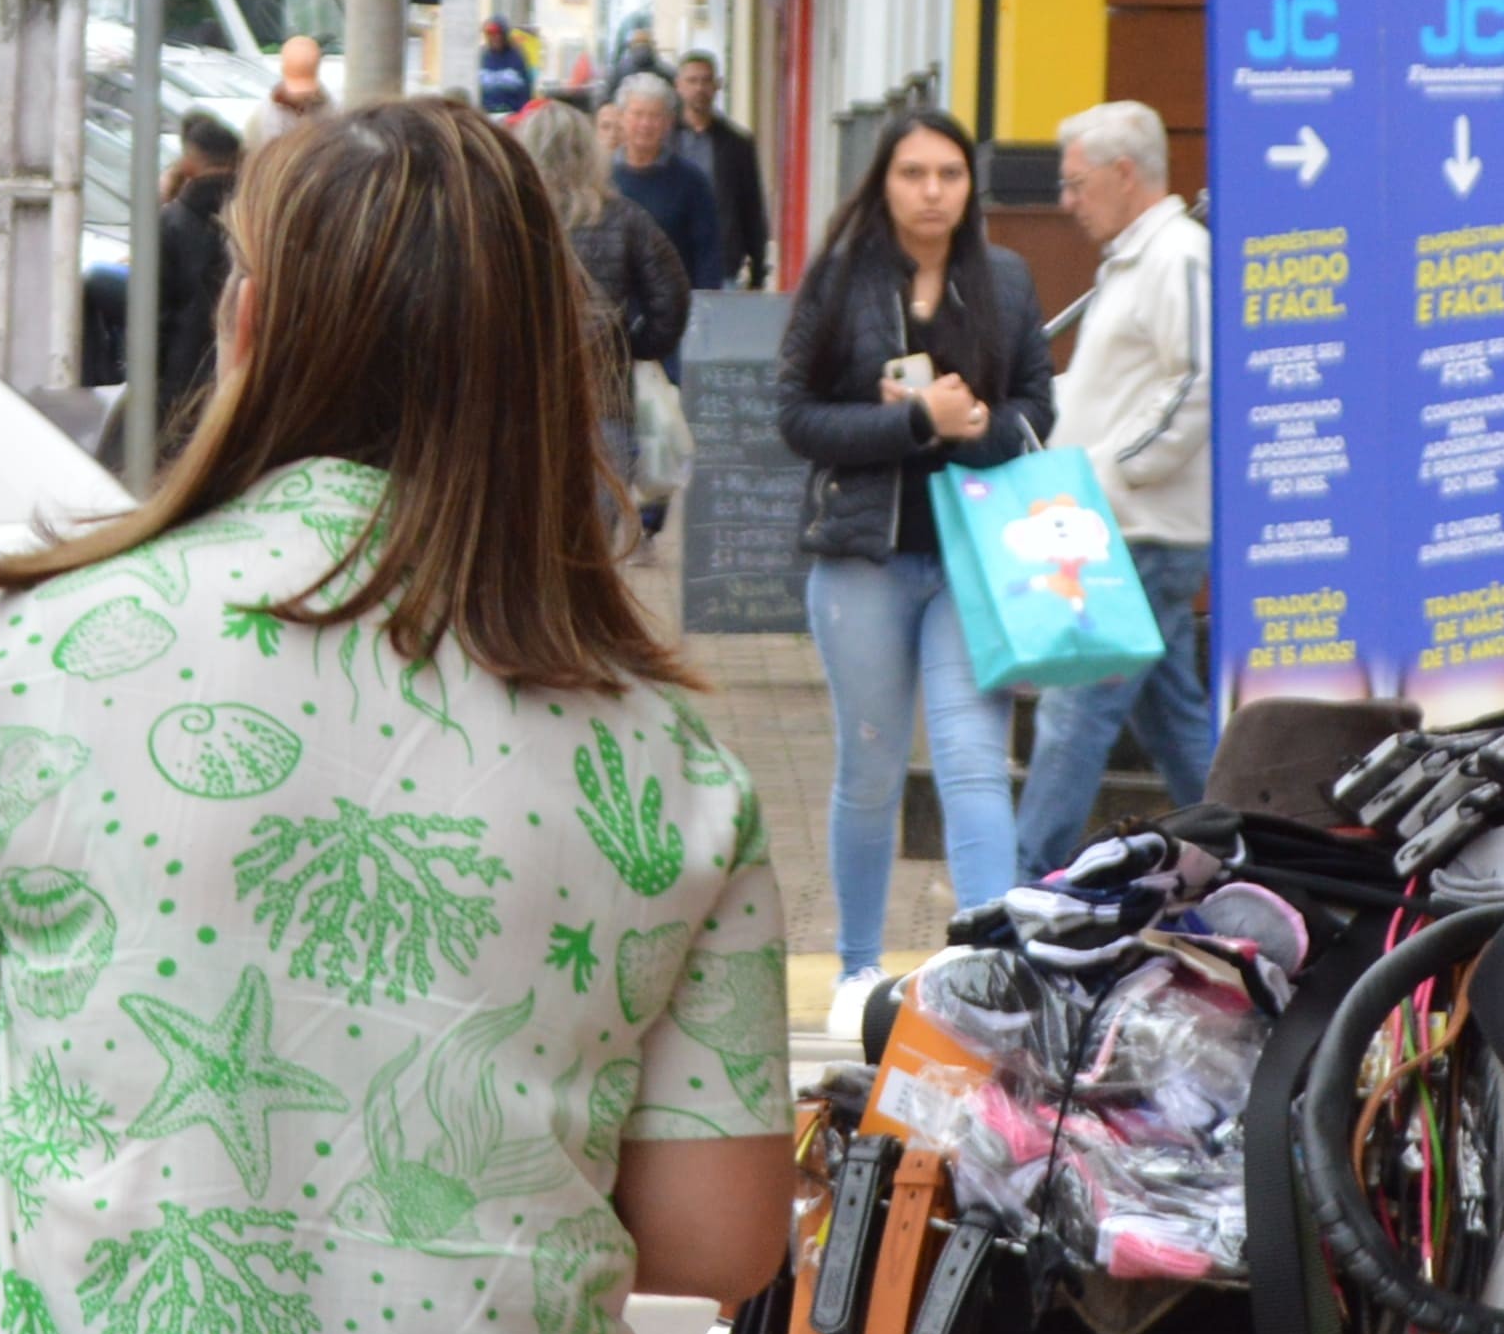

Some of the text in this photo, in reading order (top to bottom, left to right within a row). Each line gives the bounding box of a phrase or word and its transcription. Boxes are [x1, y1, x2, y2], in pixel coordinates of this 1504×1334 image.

[1244, 251, 1350, 291] RÁPIDO
[1244, 281, 1347, 326] E FÁCIL.
[1417, 292, 1434, 324] E
[1264, 621, 1289, 643] DE
[1434, 620, 1458, 643] DE
[1249, 647, 1274, 668] DE
[1421, 647, 1445, 670] DE
